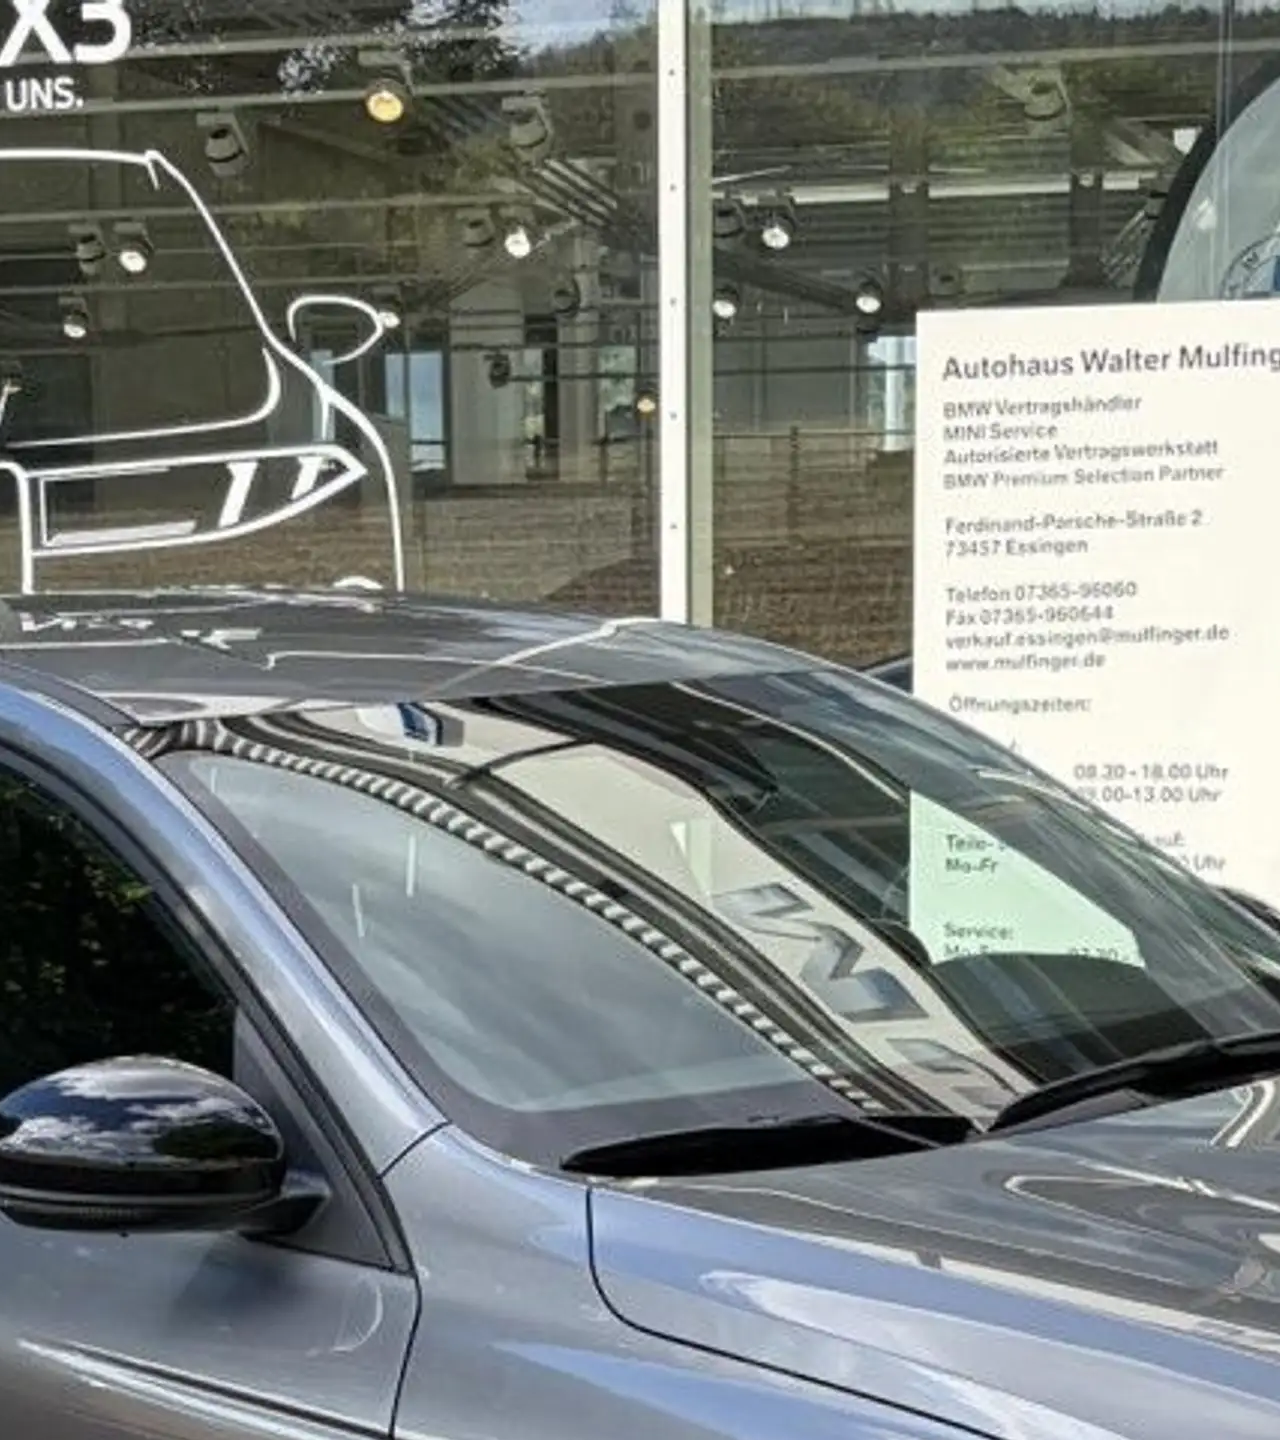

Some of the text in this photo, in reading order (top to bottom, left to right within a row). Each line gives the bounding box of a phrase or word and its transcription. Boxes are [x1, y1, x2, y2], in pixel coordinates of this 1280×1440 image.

[5, 76, 83, 112] UNS.
[942, 353, 1074, 381] Autohaus
[1080, 348, 1171, 373] Walter
[943, 395, 1142, 419] BMW Vertragshändler
[943, 422, 1058, 441] MINI Service
[944, 440, 1218, 466] Autorisierte Vertragswerkstatt
[943, 465, 1225, 490] BMW Premium Selection Partner
[946, 509, 1202, 535] Ferdinand-Porsche-Straße 2
[946, 538, 1088, 558] 73457 Essingen
[946, 586, 1010, 603] Telefon
[946, 608, 976, 626] Fax
[1195, 763, 1228, 780] Uhr
[1188, 786, 1222, 802] Uhr
[1194, 855, 1226, 872] Uhr
[944, 922, 1013, 941] Service:
